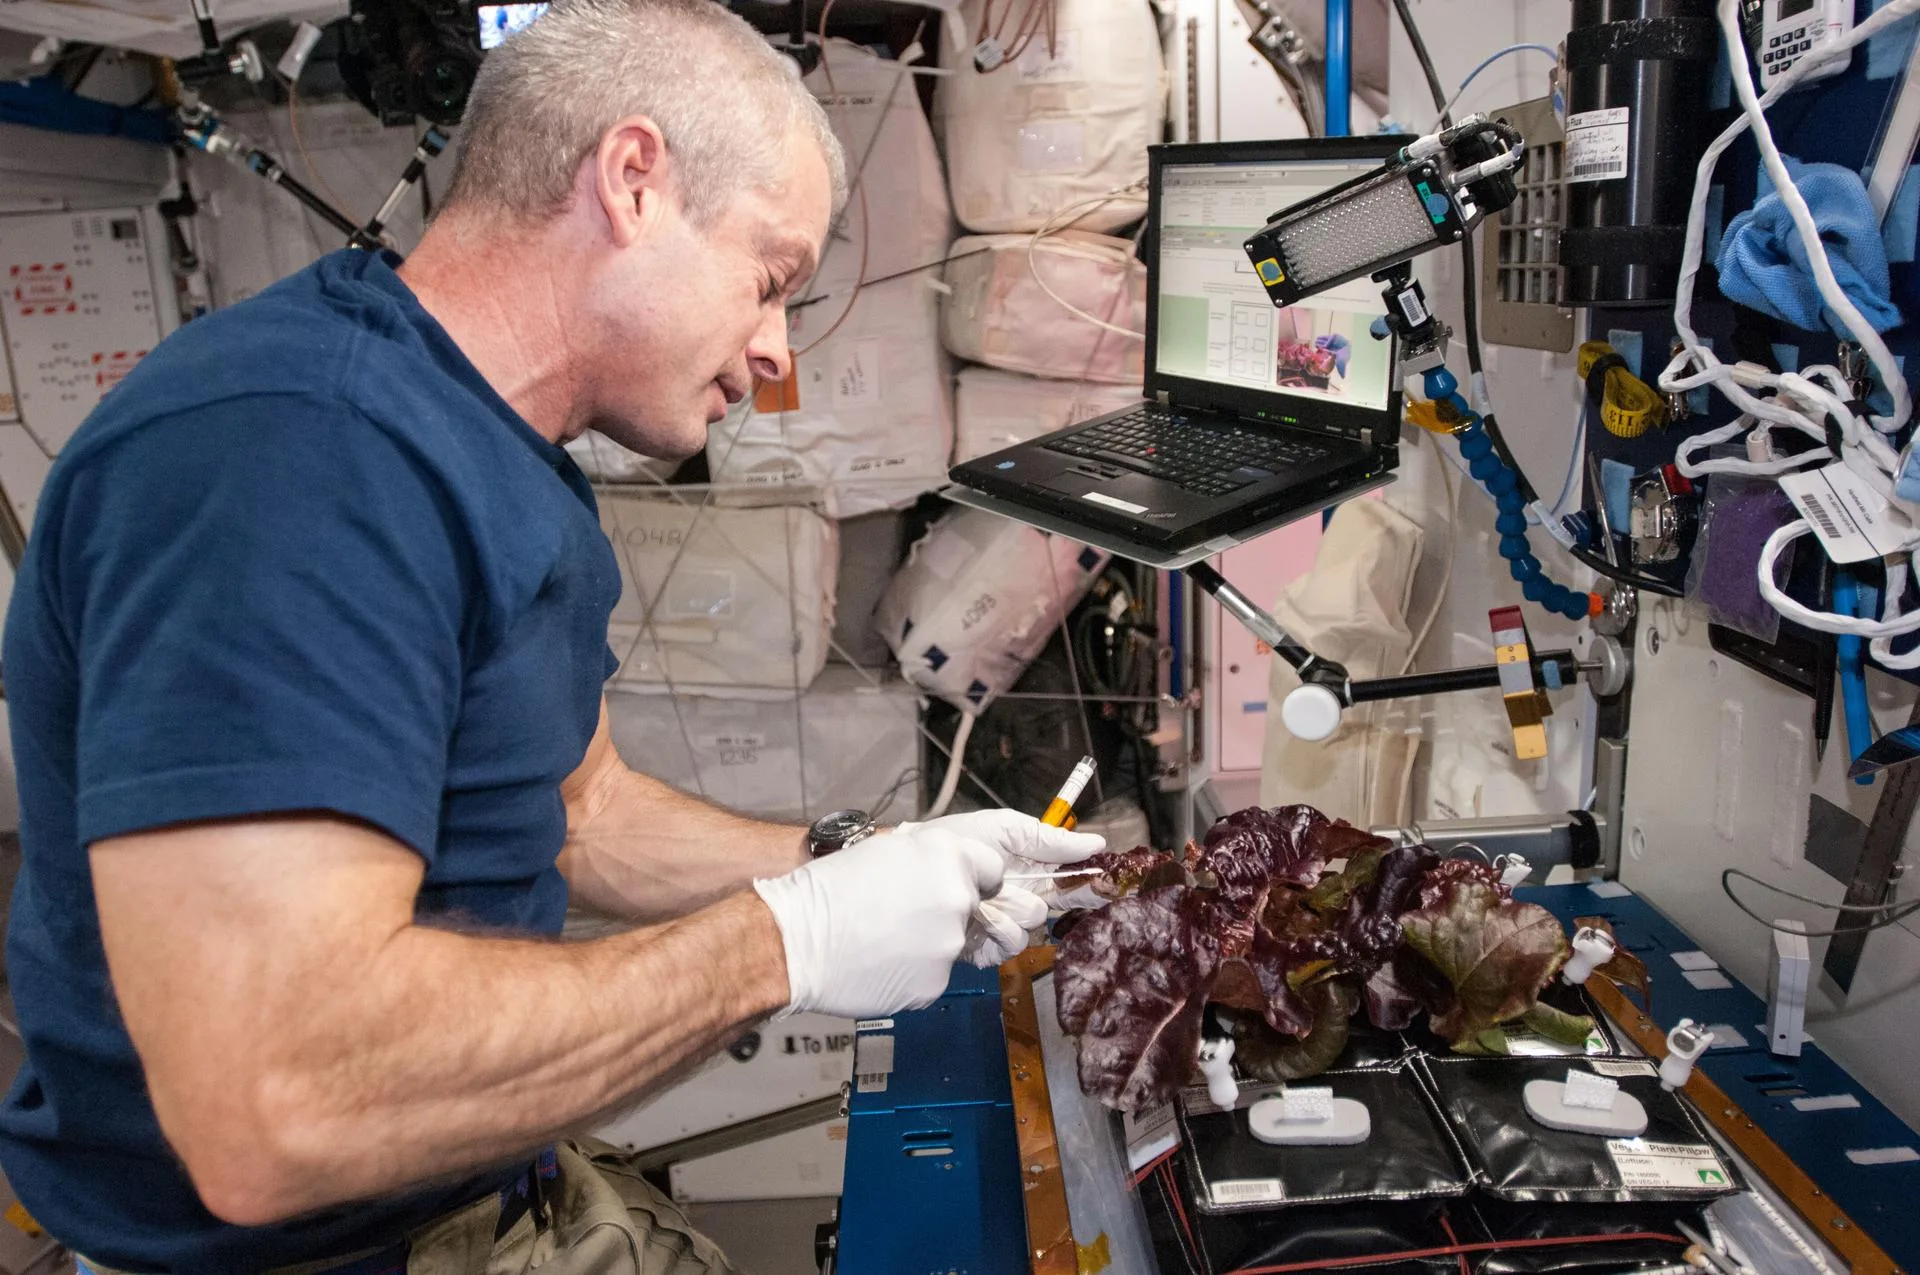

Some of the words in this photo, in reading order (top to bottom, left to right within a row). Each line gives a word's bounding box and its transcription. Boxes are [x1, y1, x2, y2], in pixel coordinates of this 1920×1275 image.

[801, 1035, 822, 1054] To
[825, 1034, 855, 1053] MP
[1648, 1144, 1677, 1153] Plant
[1678, 1146, 1711, 1156] Pillow
